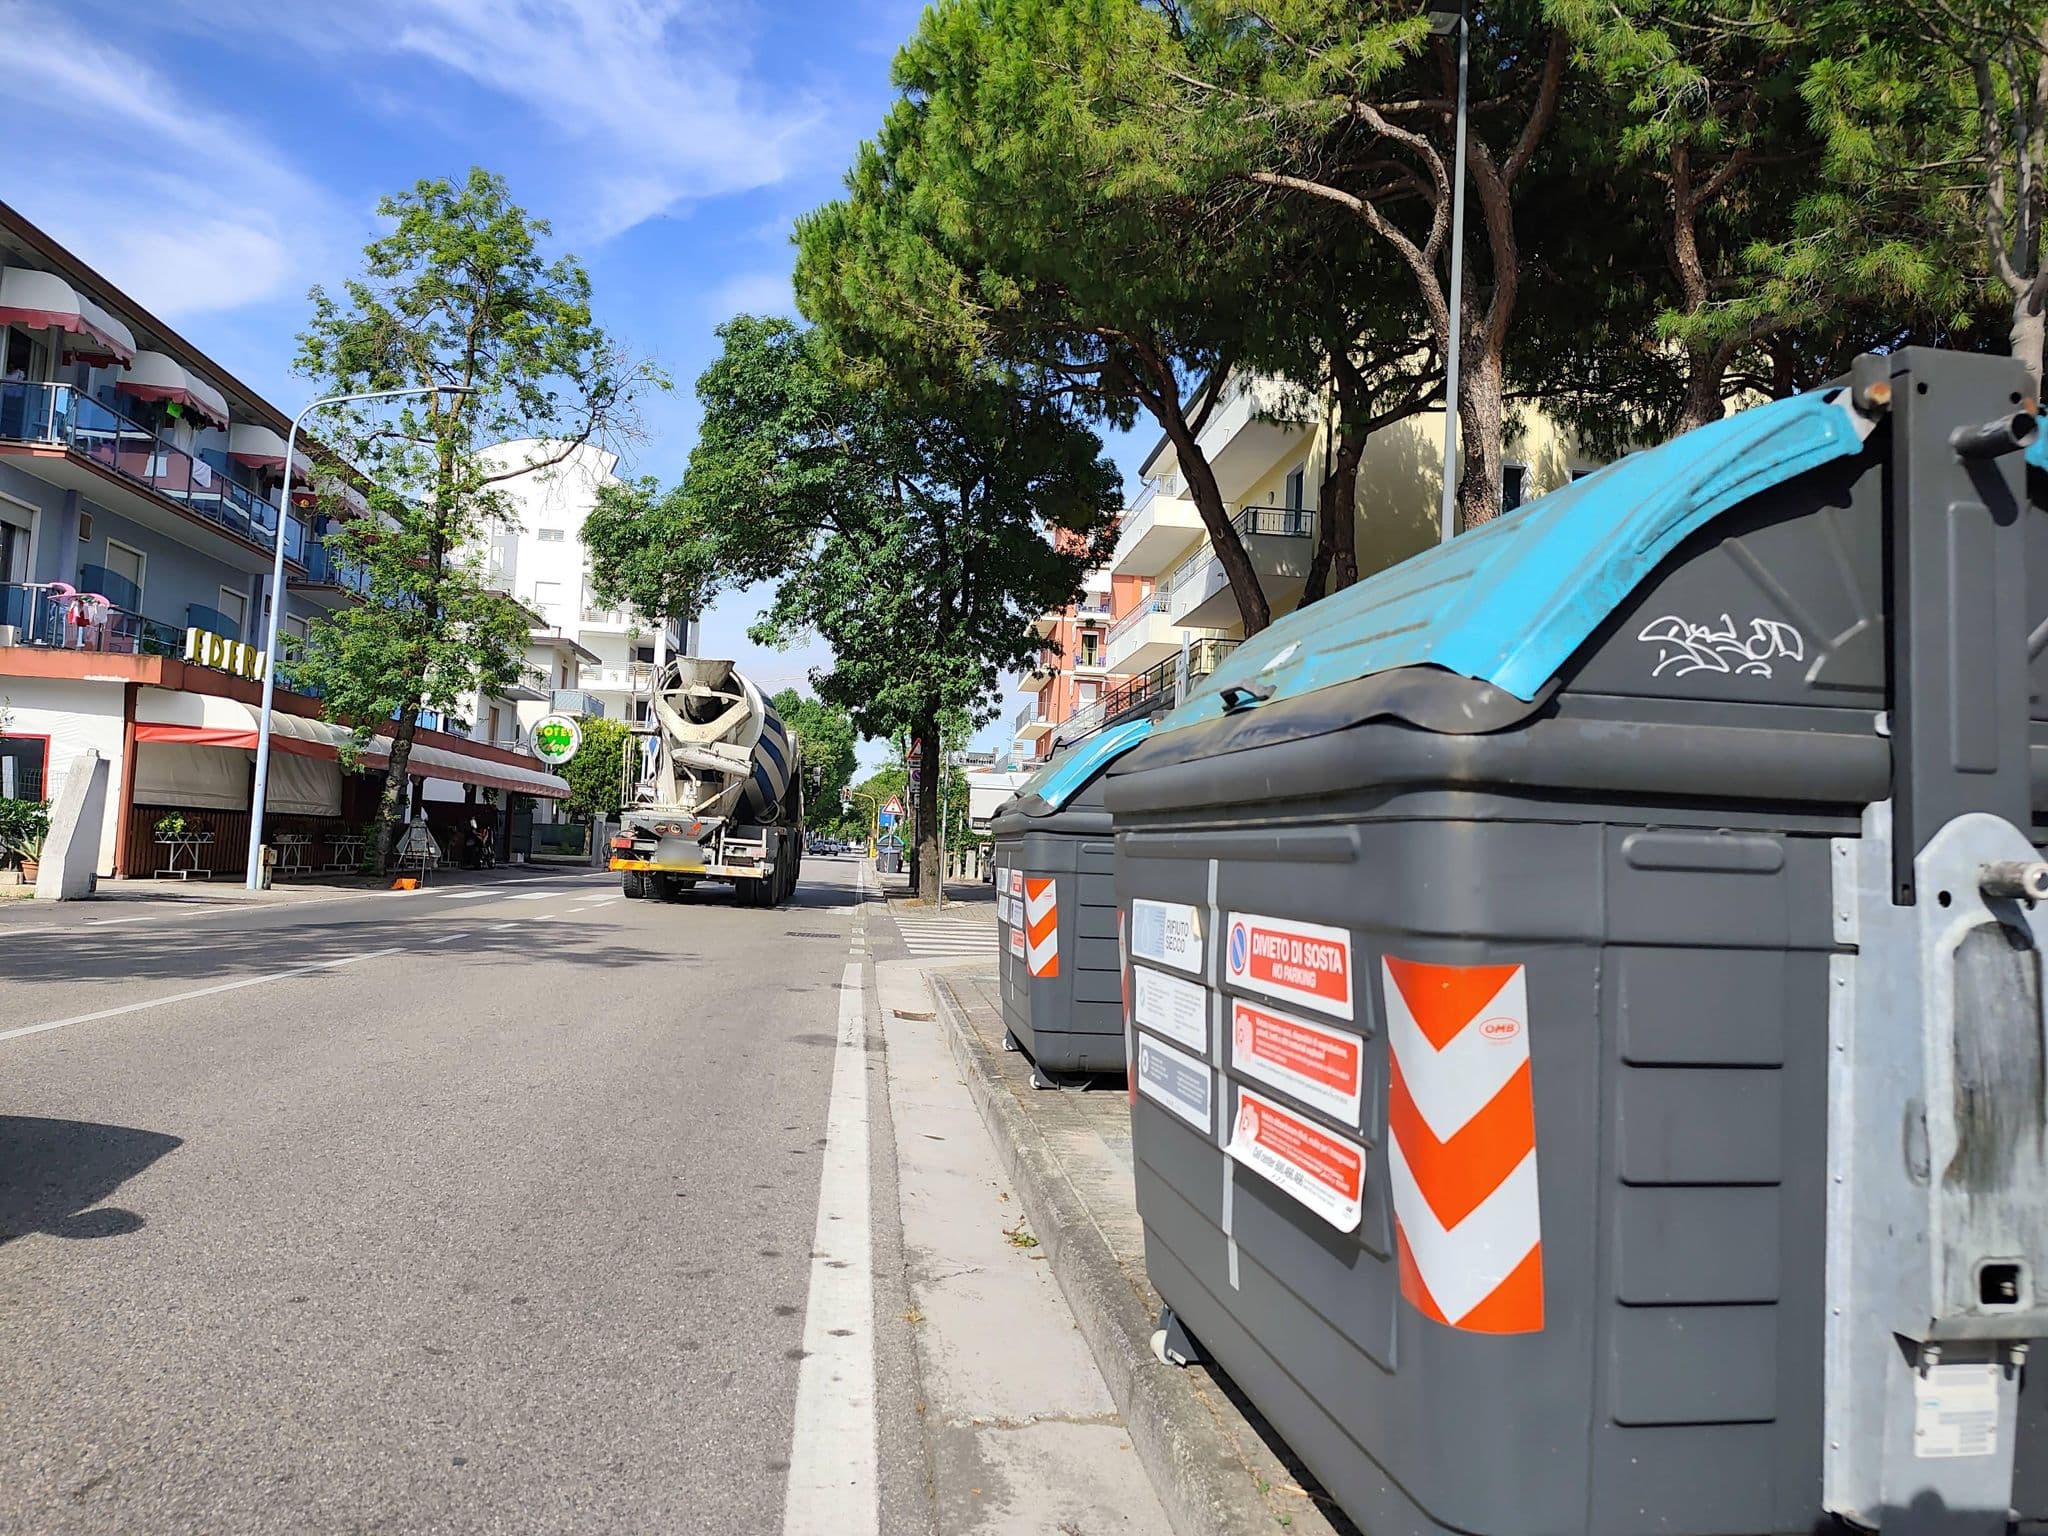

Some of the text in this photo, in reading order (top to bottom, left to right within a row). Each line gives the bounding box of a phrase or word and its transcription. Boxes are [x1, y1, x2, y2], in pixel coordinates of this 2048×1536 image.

[535, 726, 574, 738] HOTEL
[1166, 919, 1190, 937] RIFIUTO
[1165, 935, 1185, 953] SECCO
[1252, 933, 1344, 976] DIVIETO DI SOSTA
[1271, 962, 1317, 990] NO PARKING
[1485, 1023, 1515, 1034] OMB
